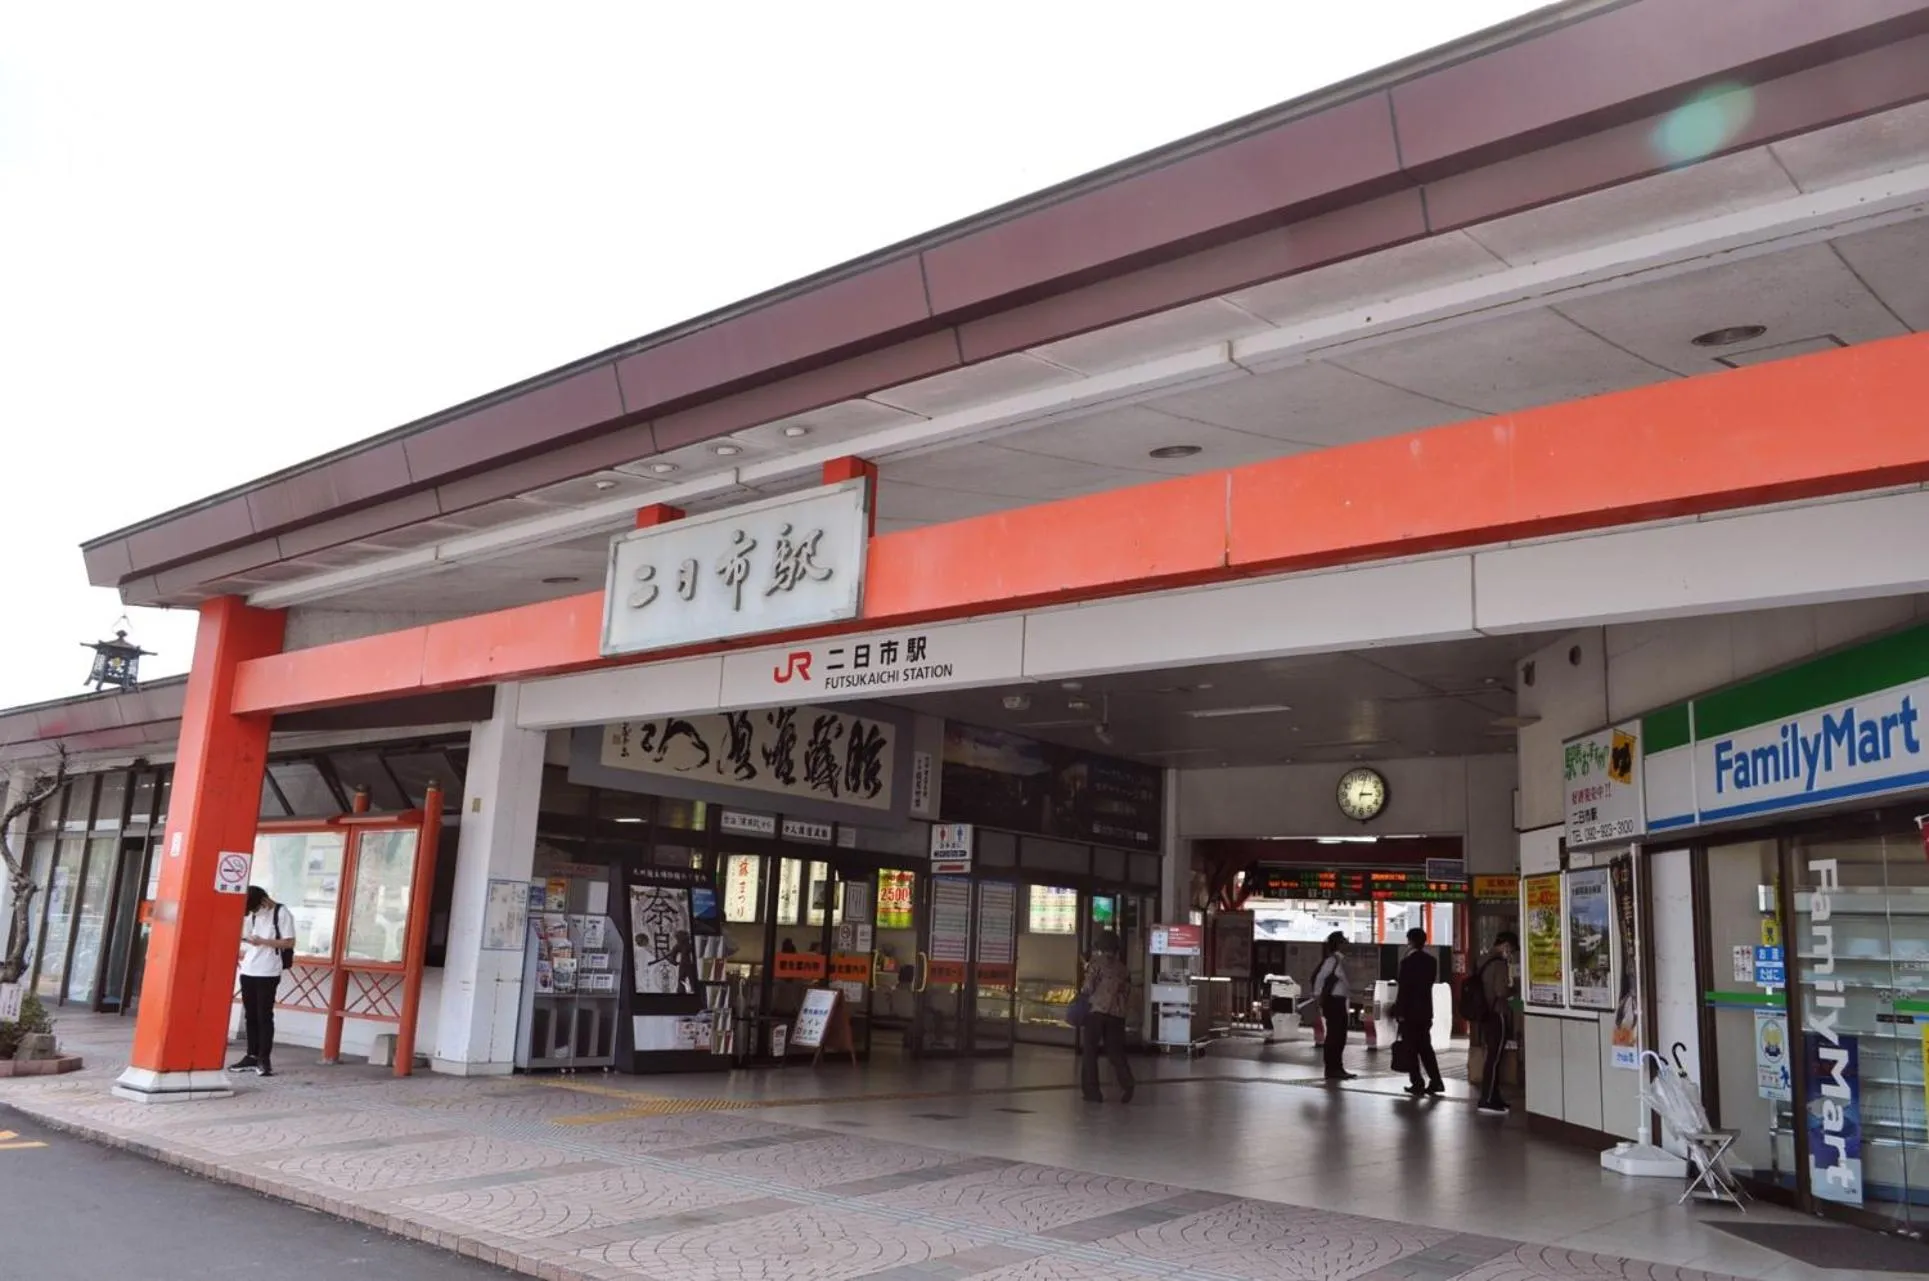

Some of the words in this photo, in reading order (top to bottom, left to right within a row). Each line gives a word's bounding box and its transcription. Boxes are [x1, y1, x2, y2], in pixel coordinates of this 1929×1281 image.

[628, 523, 834, 612] 二日市駅
[773, 651, 813, 684] JR
[824, 669, 900, 691] FUTSUKAICHI
[902, 663, 954, 682] STATION
[826, 636, 928, 671] 二日市駅
[1714, 695, 1921, 794] FamilyMart
[642, 886, 681, 966] 奈良
[1807, 858, 1857, 1189] FamilyMart
